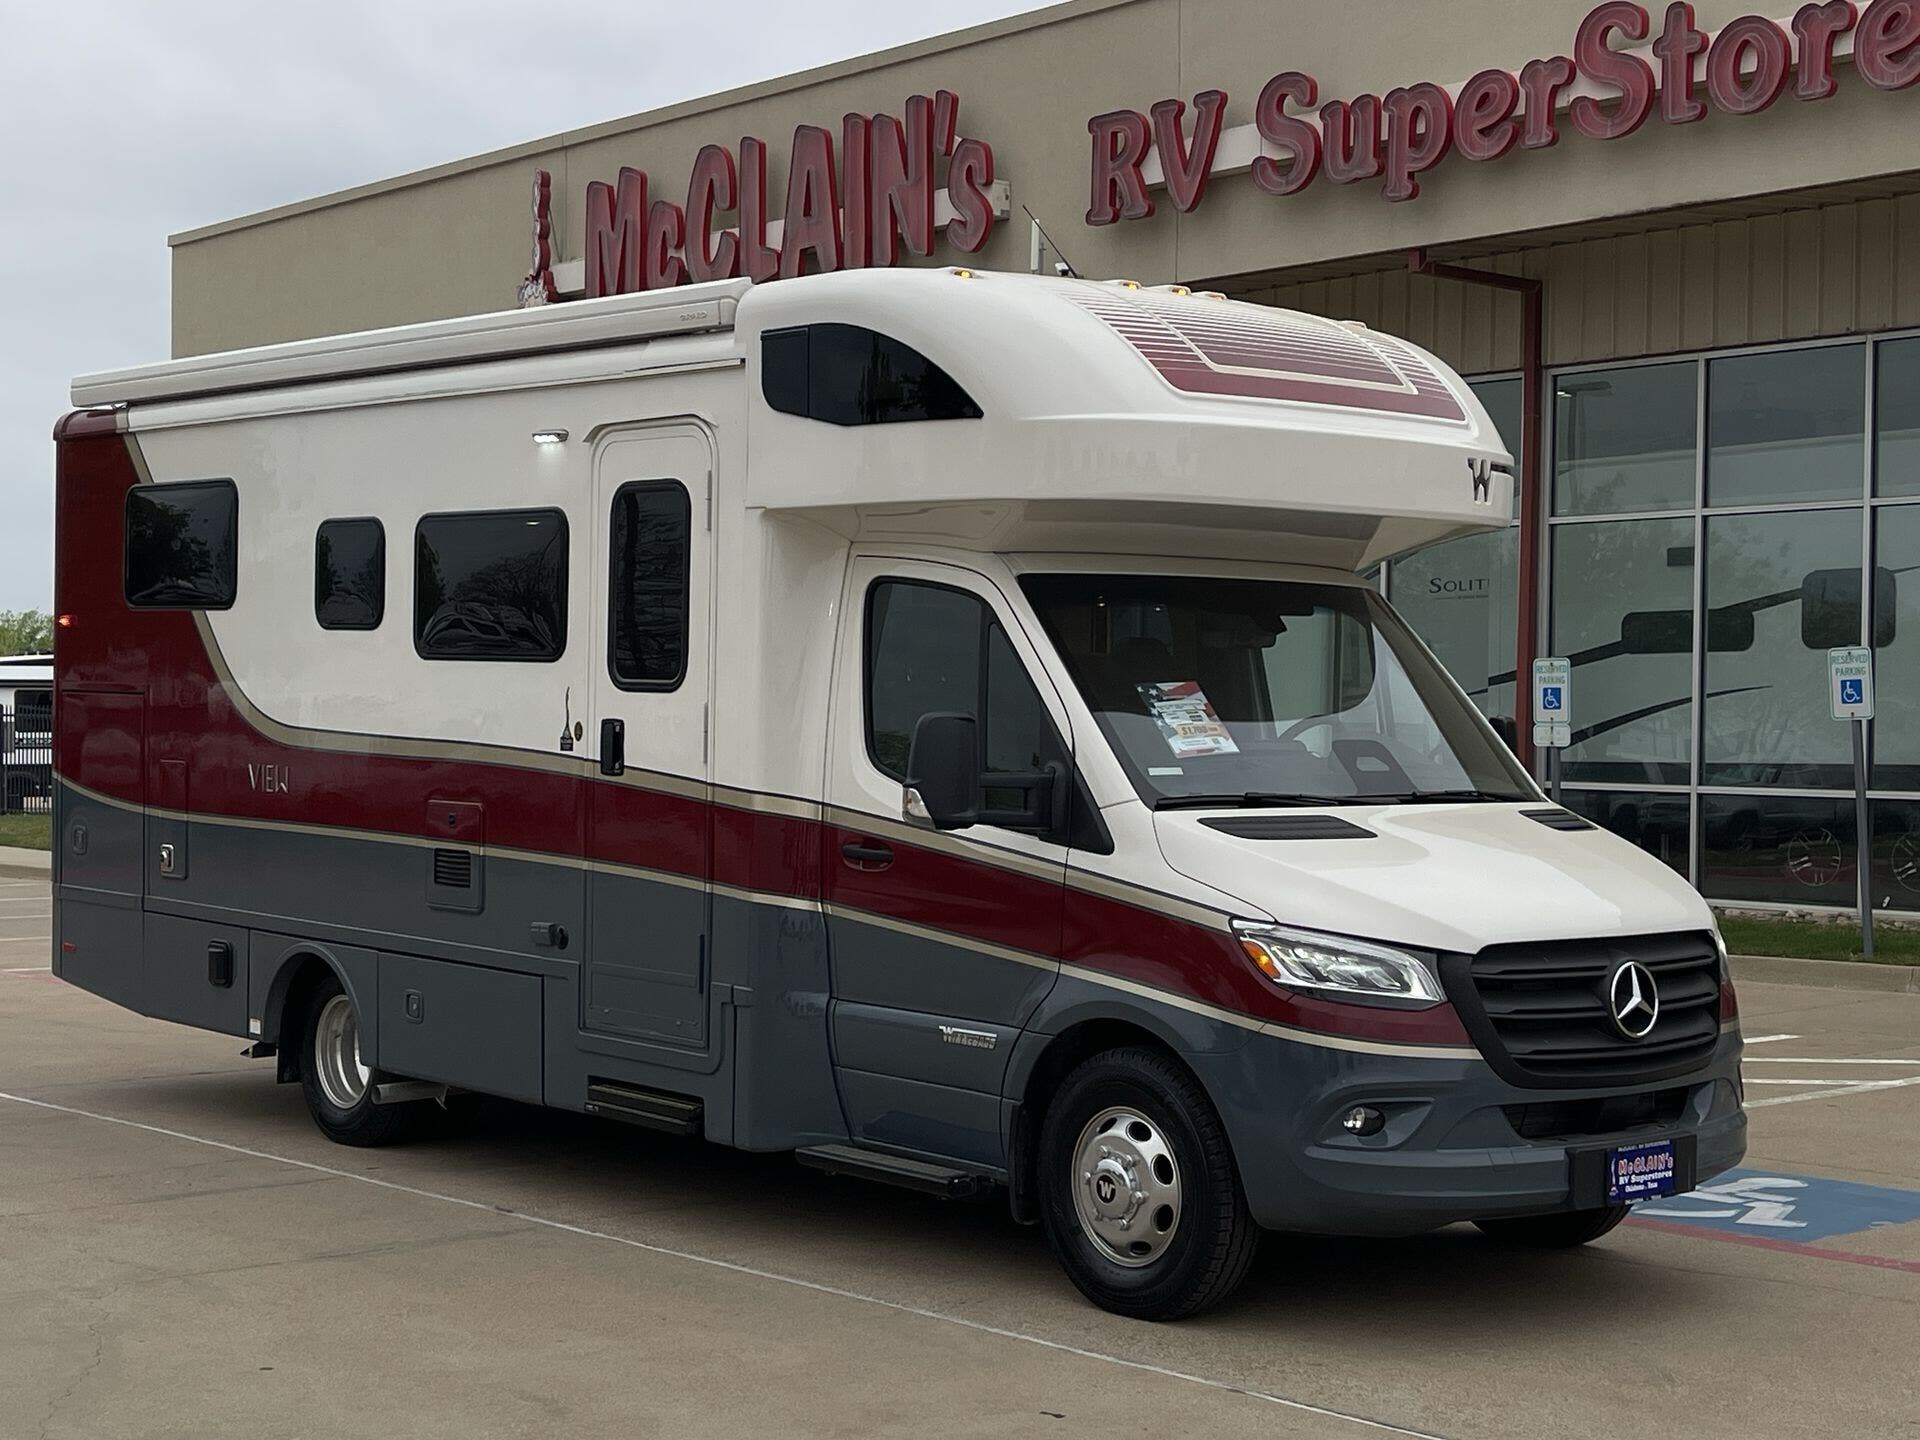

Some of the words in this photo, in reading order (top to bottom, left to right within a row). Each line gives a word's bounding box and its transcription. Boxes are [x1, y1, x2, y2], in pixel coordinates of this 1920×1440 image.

[1085, 89, 1229, 226] RV
[585, 89, 995, 299] McCLAIN's
[1467, 457, 1494, 502] W
[1429, 577, 1489, 593] SOLIT
[1831, 654, 1868, 664] RESERVED
[1536, 665, 1568, 673] RESERVED
[1836, 667, 1866, 676] PARKING
[1539, 676, 1566, 684] PARKING
[248, 763, 288, 793] VIEW
[1619, 1175, 1630, 1185] RV
[1631, 1170, 1672, 1183] Superstores
[1099, 1180, 1115, 1199] W
